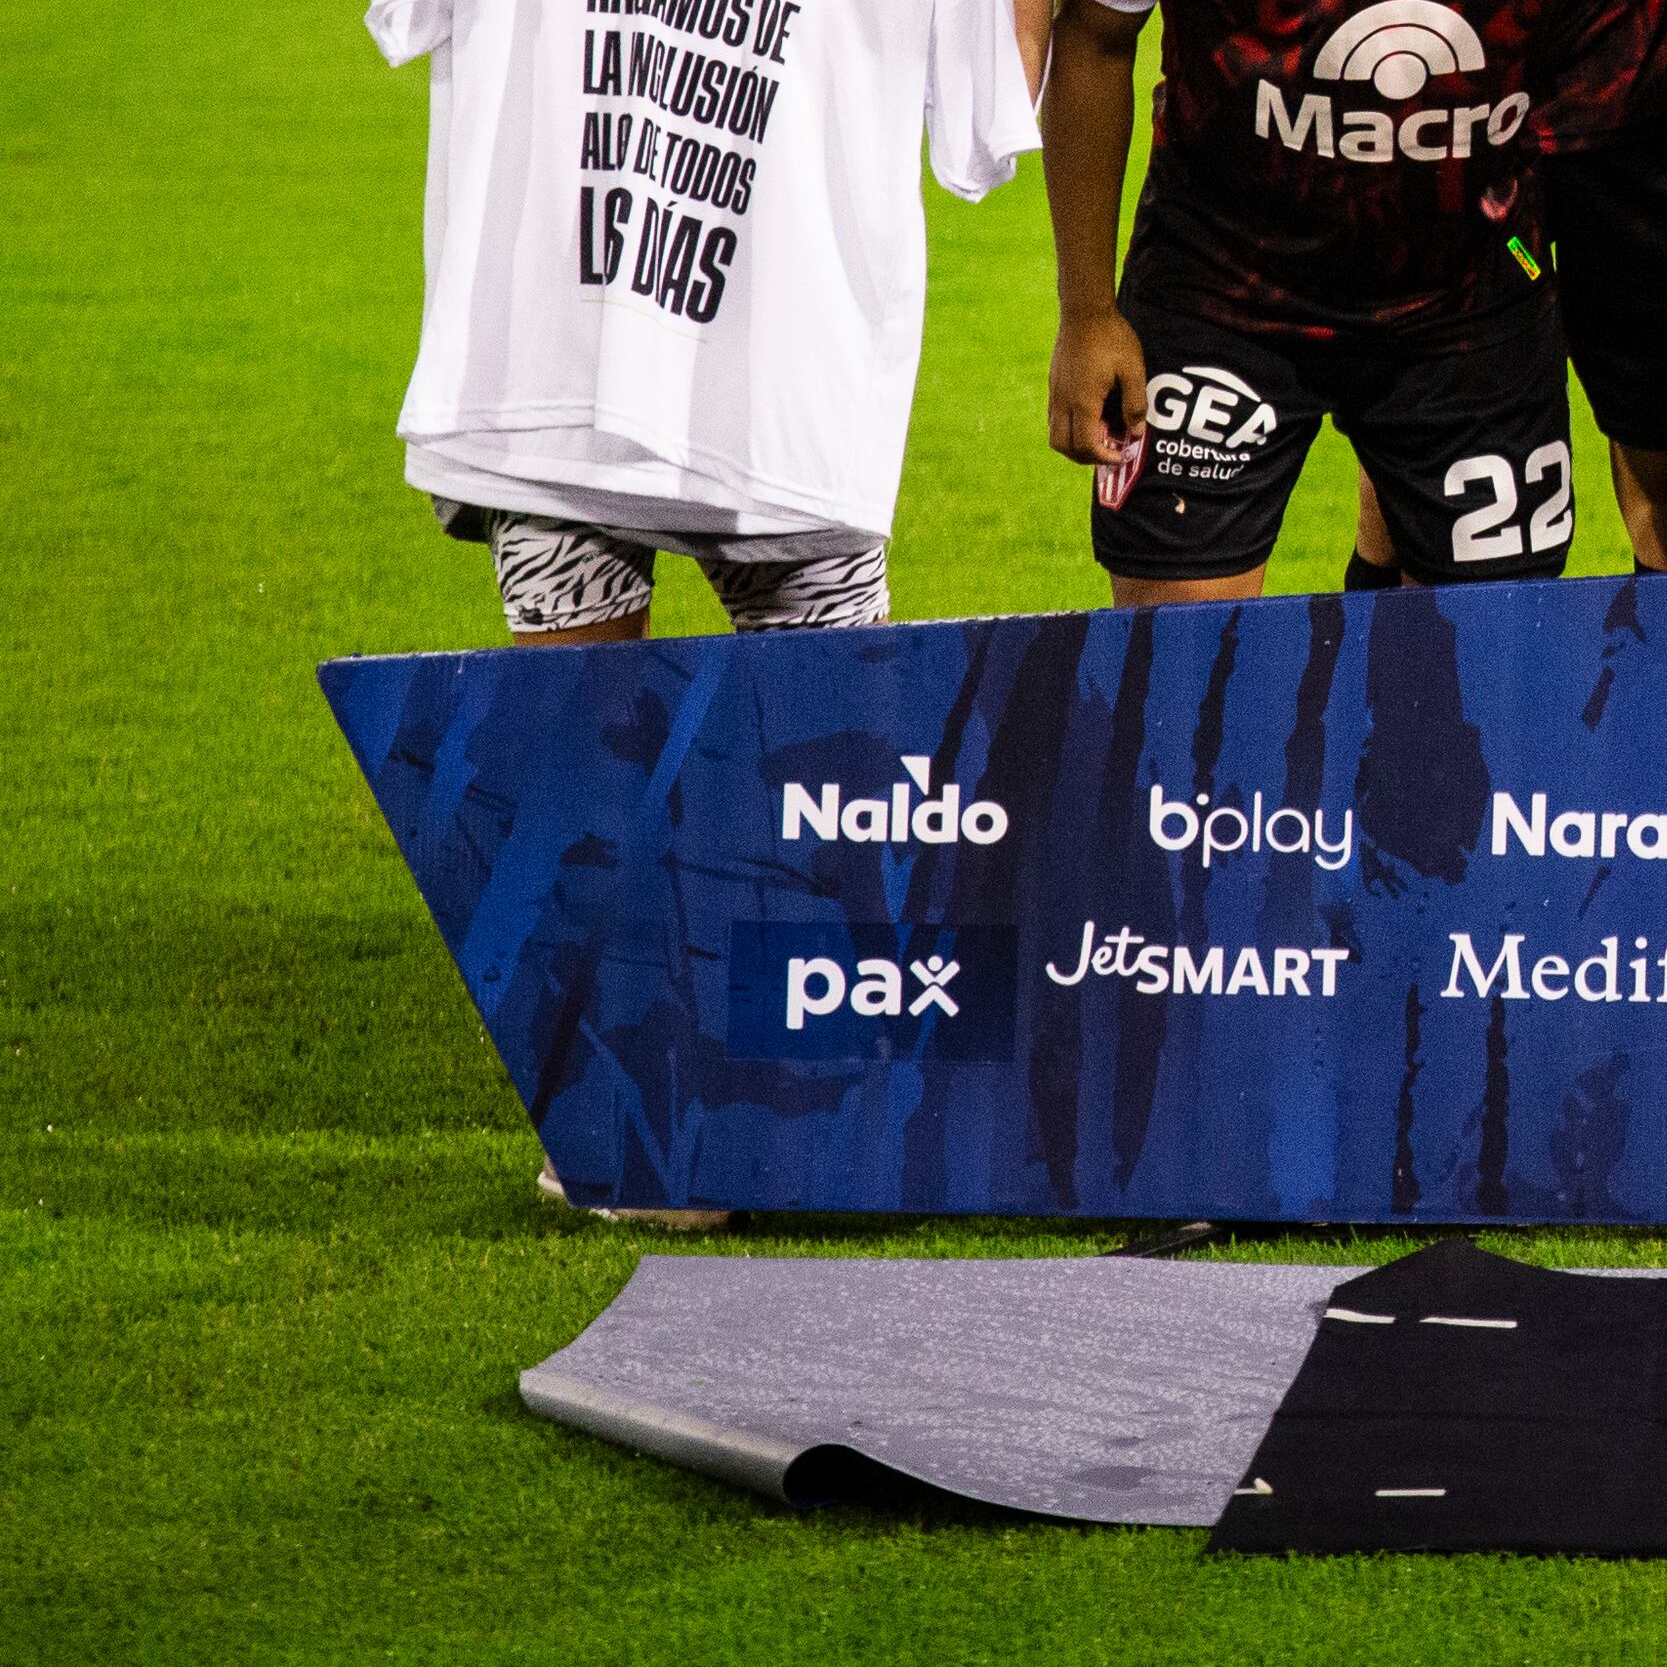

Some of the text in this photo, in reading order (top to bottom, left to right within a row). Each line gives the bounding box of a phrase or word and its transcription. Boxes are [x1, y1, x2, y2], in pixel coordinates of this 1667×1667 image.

[582, 29, 780, 145] LA INCLUSIÓN
[1254, 78, 1530, 163] Macro
[632, 117, 662, 183] DE
[660, 131, 757, 216] TODOS
[631, 197, 738, 324] DÍAS
[1145, 372, 1278, 449] GEA
[1157, 457, 1183, 476] de
[1443, 439, 1573, 563] 22
[782, 757, 1008, 845] Naldo
[786, 955, 960, 1029] pax
[1046, 920, 1349, 996] JetSMART
